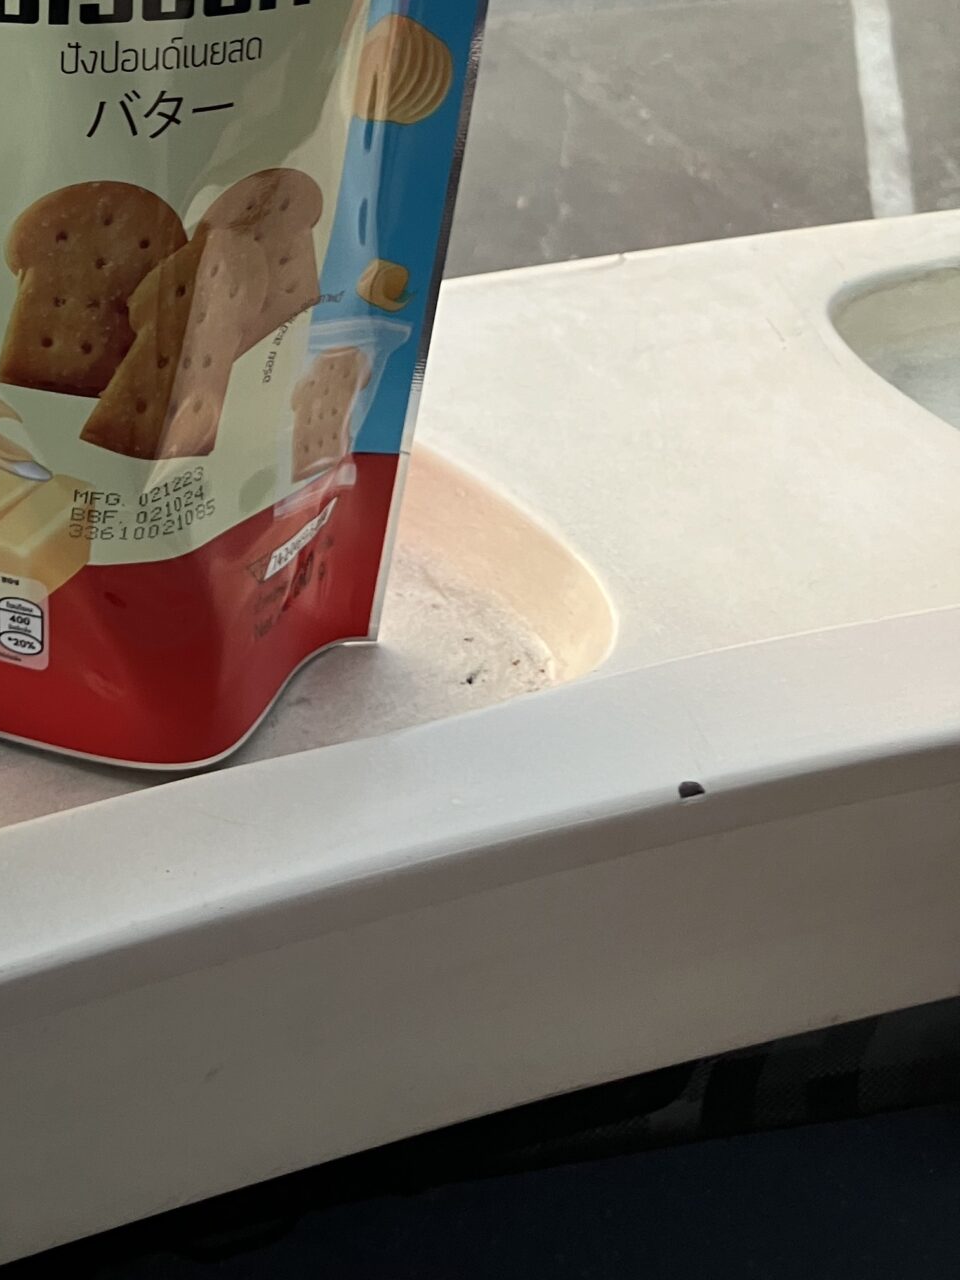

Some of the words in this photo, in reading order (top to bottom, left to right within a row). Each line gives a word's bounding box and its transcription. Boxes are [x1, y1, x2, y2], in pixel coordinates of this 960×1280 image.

[60, 36, 262, 74] ปังปอนด์เนยสด
[86, 89, 235, 139] バター
[73, 489, 126, 507] MFG.
[138, 465, 205, 507] 021223
[135, 485, 204, 524] 021024
[68, 498, 216, 541] 33610021085
[9, 614, 31, 626] 400
